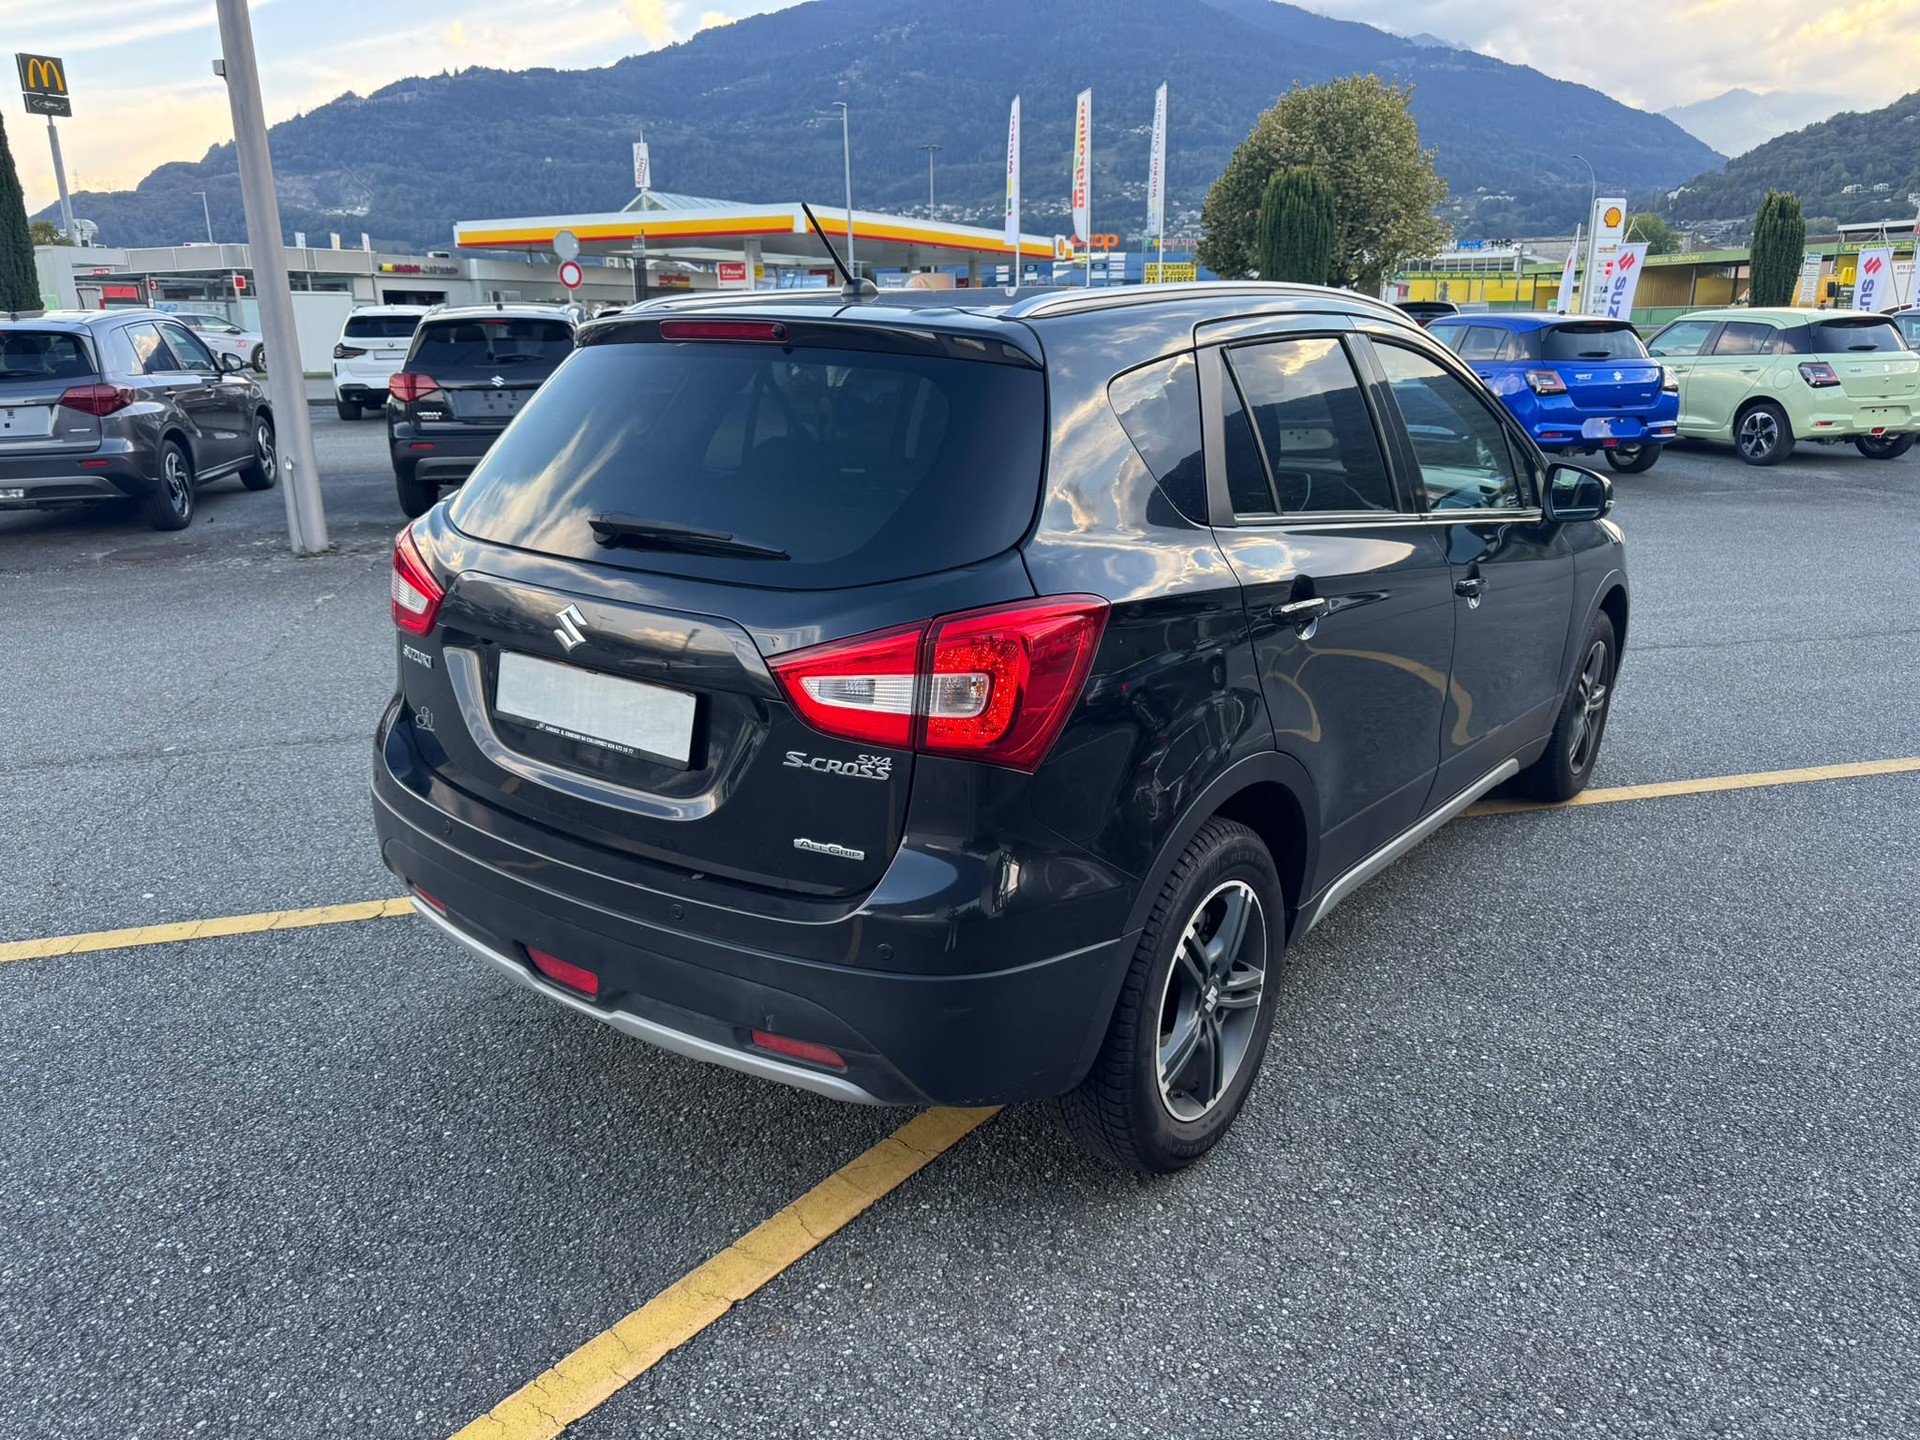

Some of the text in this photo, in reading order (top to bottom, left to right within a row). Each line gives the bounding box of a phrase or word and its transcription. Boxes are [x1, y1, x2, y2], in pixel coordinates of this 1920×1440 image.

[403, 644, 432, 668] SUZUKI
[782, 751, 892, 780] S-CROSS
[855, 754, 892, 769] SX4
